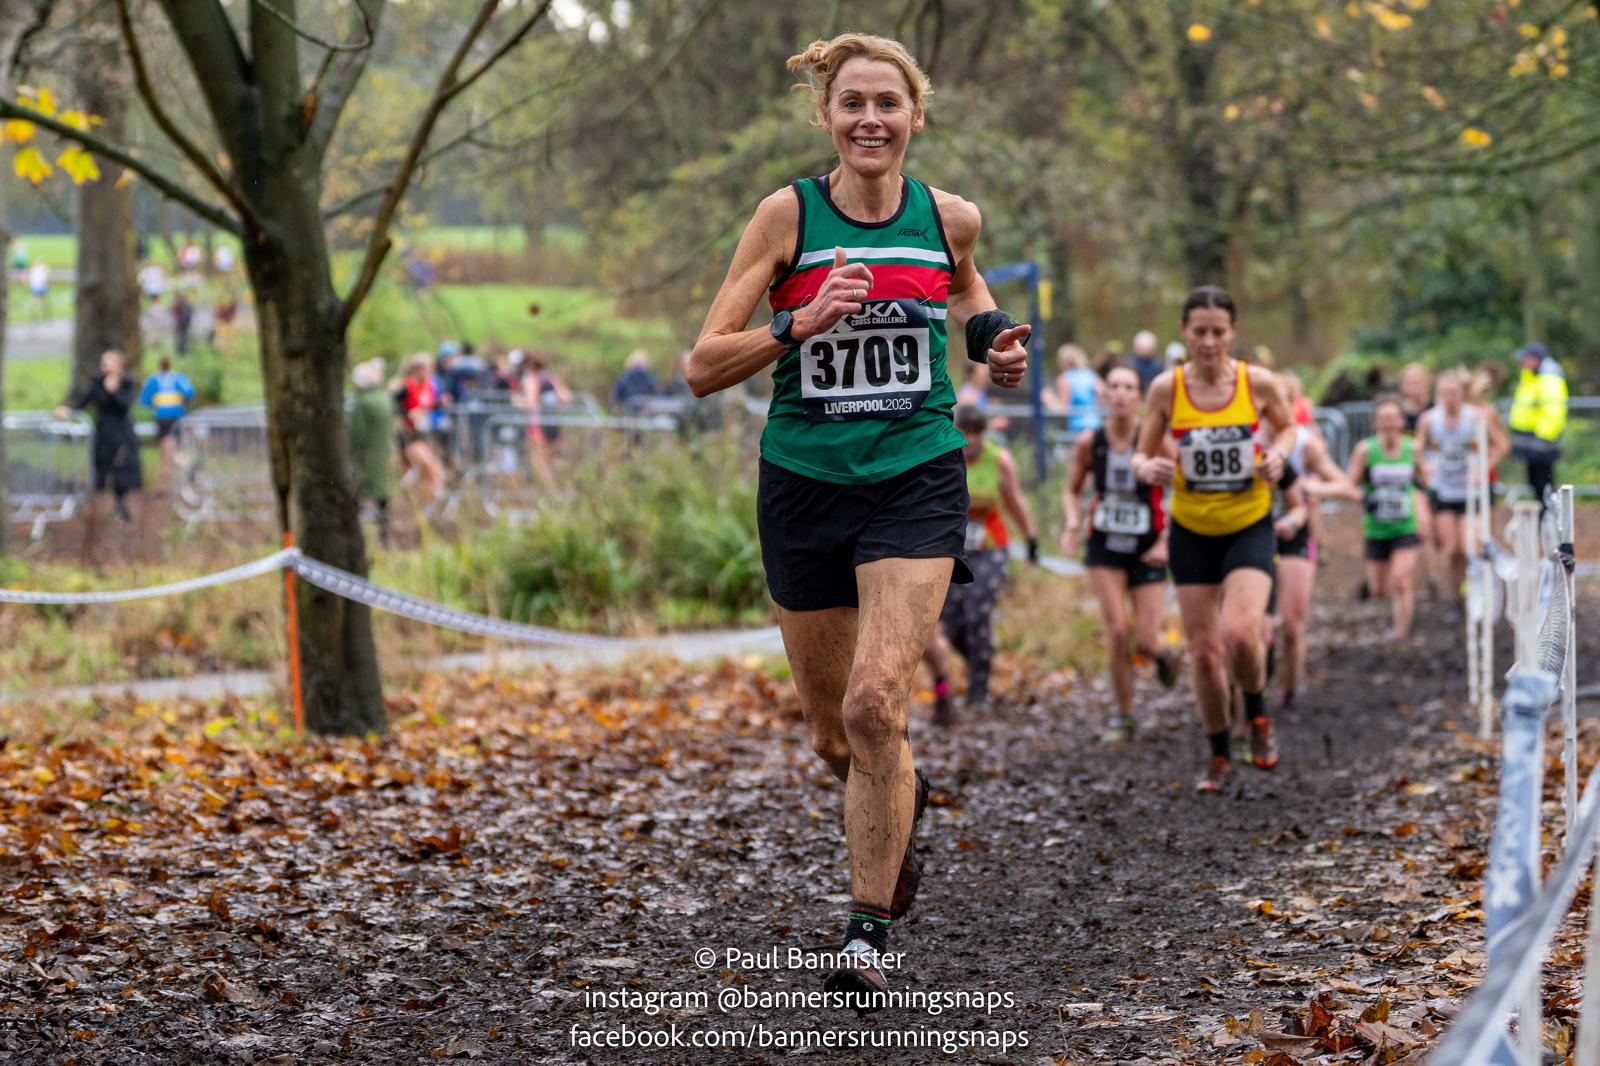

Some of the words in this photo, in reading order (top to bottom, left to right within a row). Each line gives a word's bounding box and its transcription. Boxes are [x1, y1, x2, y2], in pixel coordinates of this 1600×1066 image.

[851, 317, 871, 326] CROSS
[872, 316, 908, 325] CHALLENGE
[810, 334, 920, 391] 3709
[1193, 446, 1242, 476] 898
